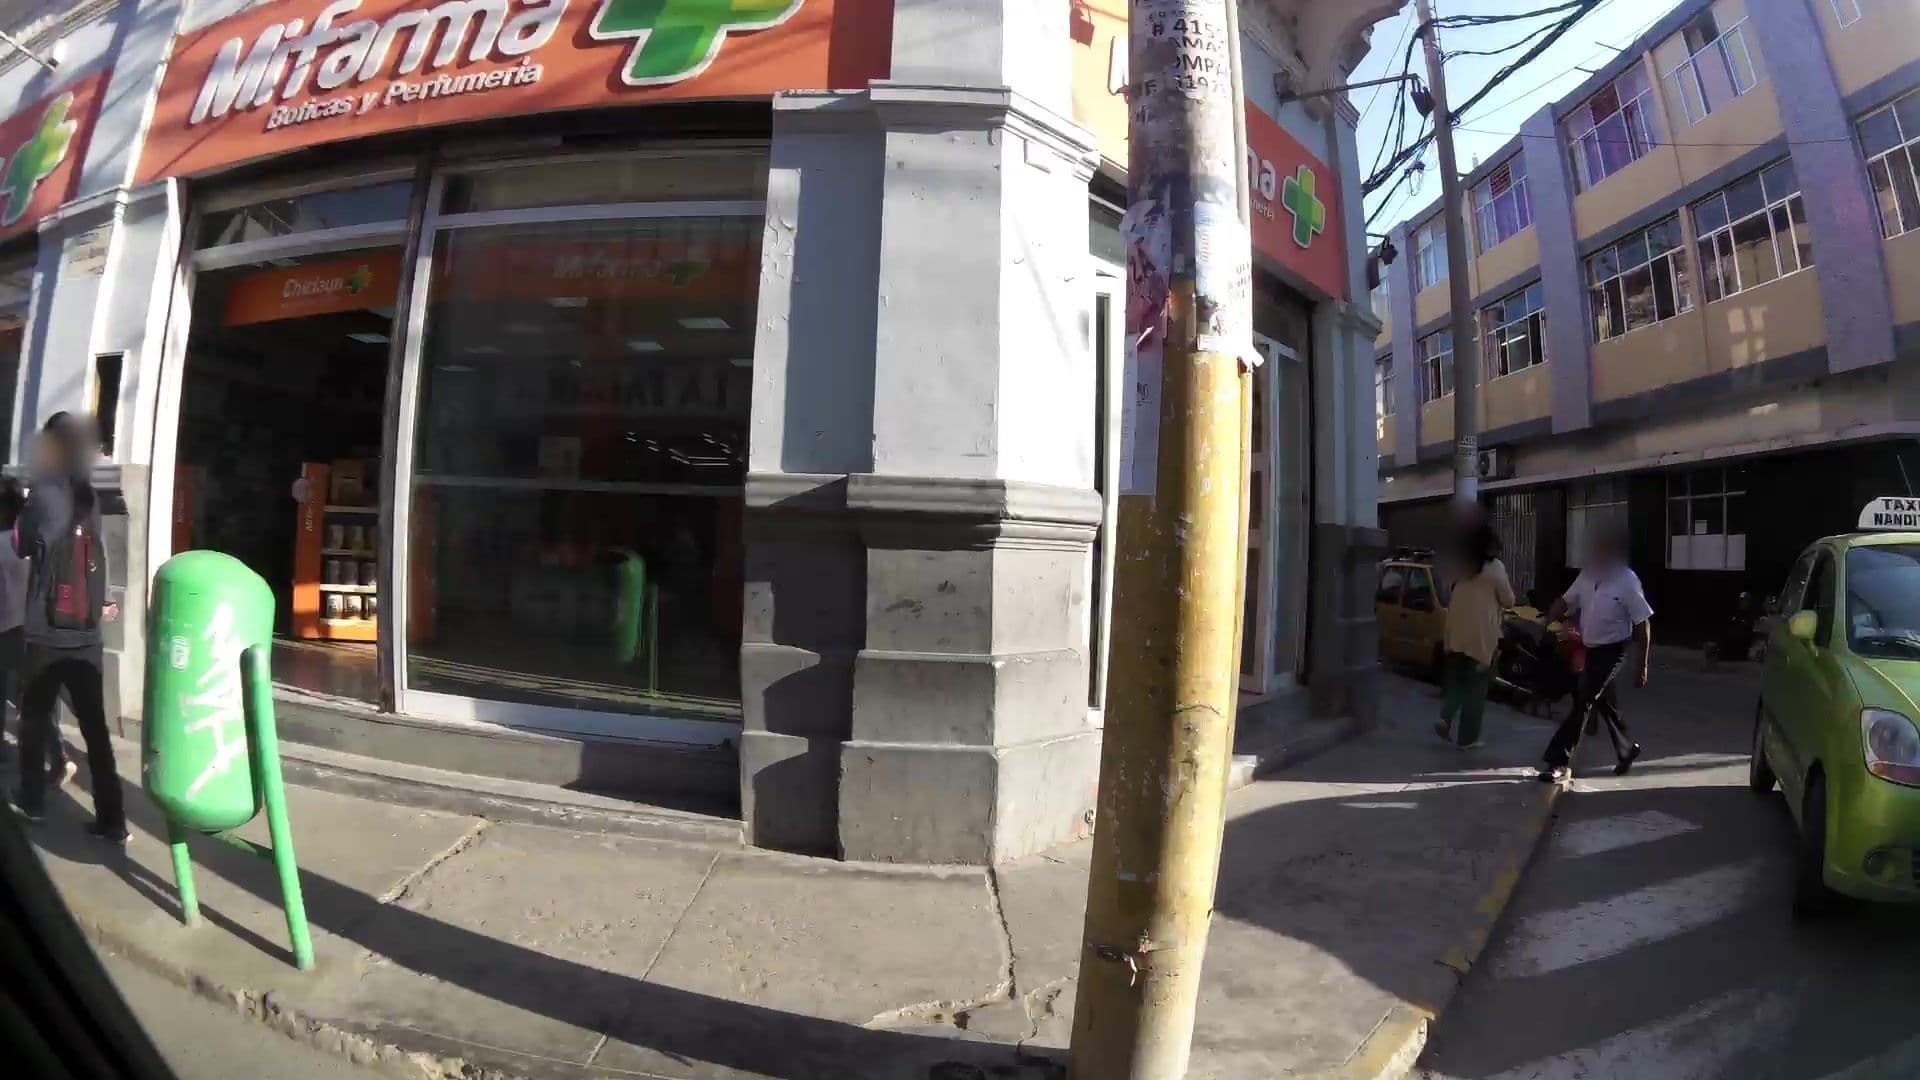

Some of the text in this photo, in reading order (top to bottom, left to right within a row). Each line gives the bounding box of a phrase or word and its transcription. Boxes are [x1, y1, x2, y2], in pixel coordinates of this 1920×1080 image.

[190, 0, 569, 124] Mifarma
[266, 96, 354, 129] Boticas
[356, 91, 379, 115] y
[1873, 512, 1920, 526] NANDI
